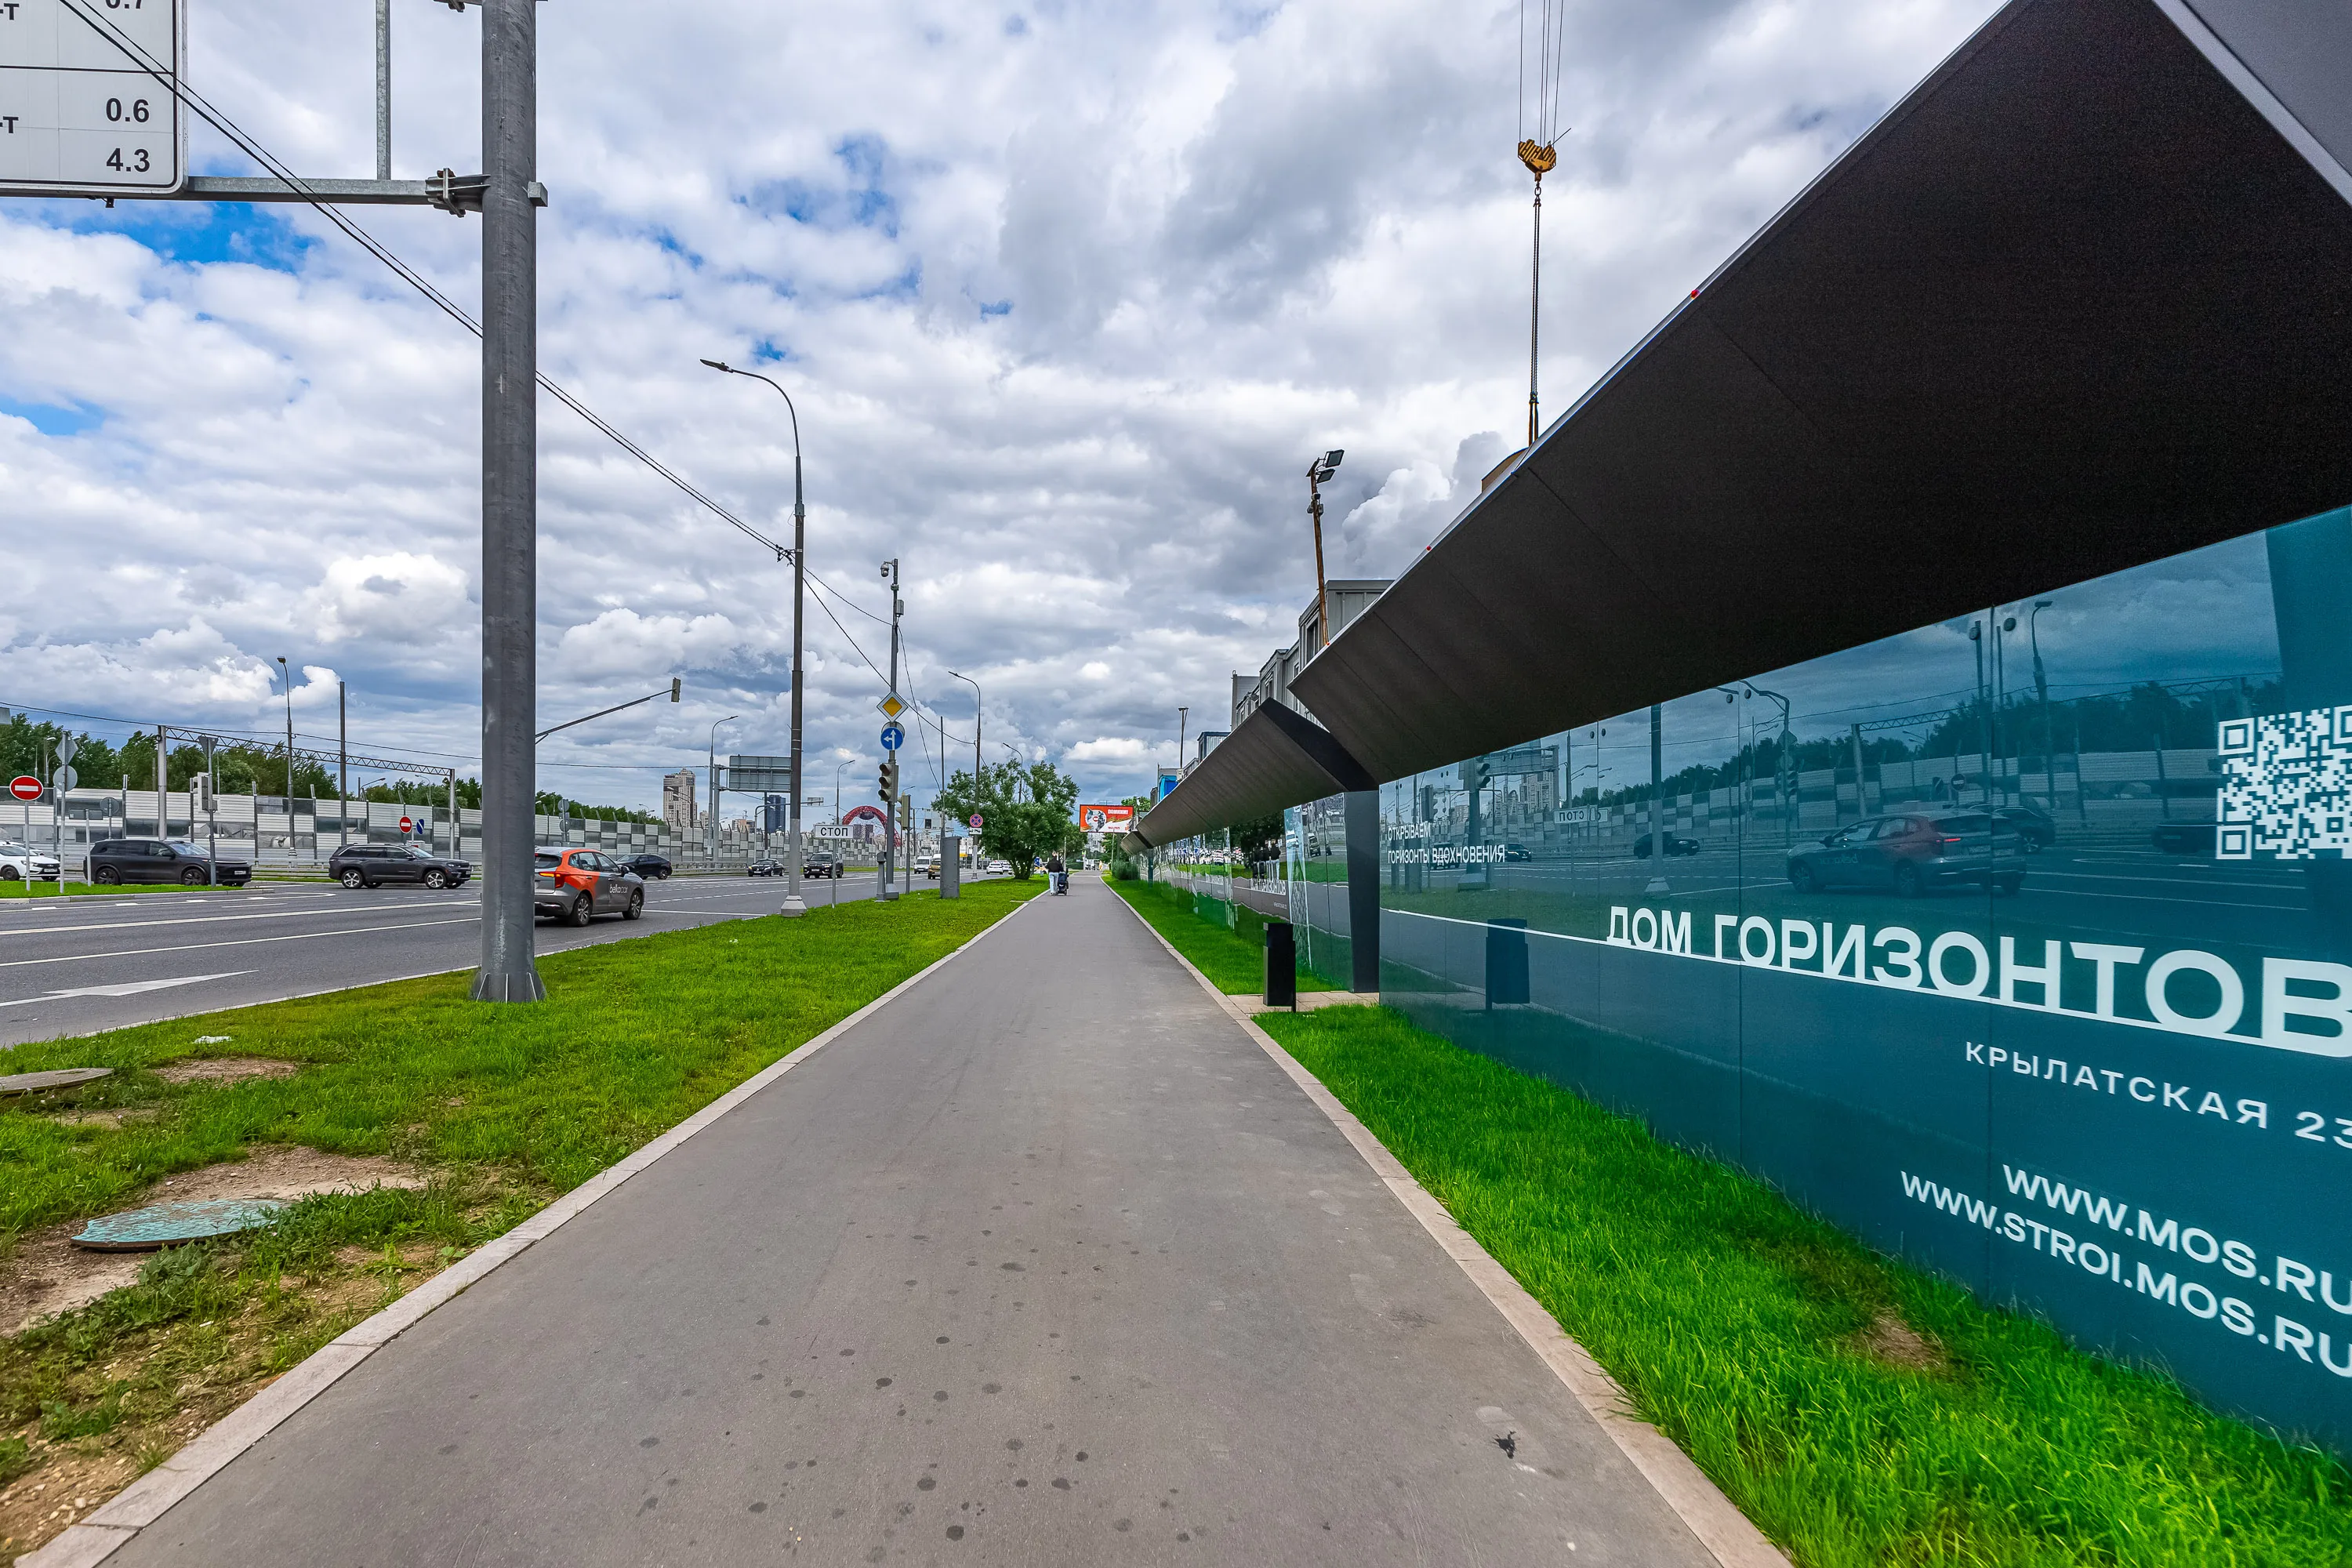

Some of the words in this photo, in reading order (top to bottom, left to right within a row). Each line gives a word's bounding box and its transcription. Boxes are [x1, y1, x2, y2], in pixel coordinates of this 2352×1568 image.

[106, 97, 150, 122] 0.6
[106, 147, 151, 172] 4.3
[820, 827, 848, 837] СТОП
[1388, 821, 1431, 840] ОТКРЫВАЕМ
[1388, 848, 1430, 864] ГОРИЗОНТЫ
[1432, 844, 1505, 866] ВДОХНОВЕНИЯ
[1606, 906, 1692, 955] ДОМ
[1715, 913, 2352, 1058] ГОРИЗОНТОВ
[1965, 1041, 2268, 1130] КРЫЛАТСКАЯ
[2003, 1164, 2352, 1315] WWW.MOS.RU
[1901, 1171, 2352, 1377] WWW.STROI.MOS.RU
